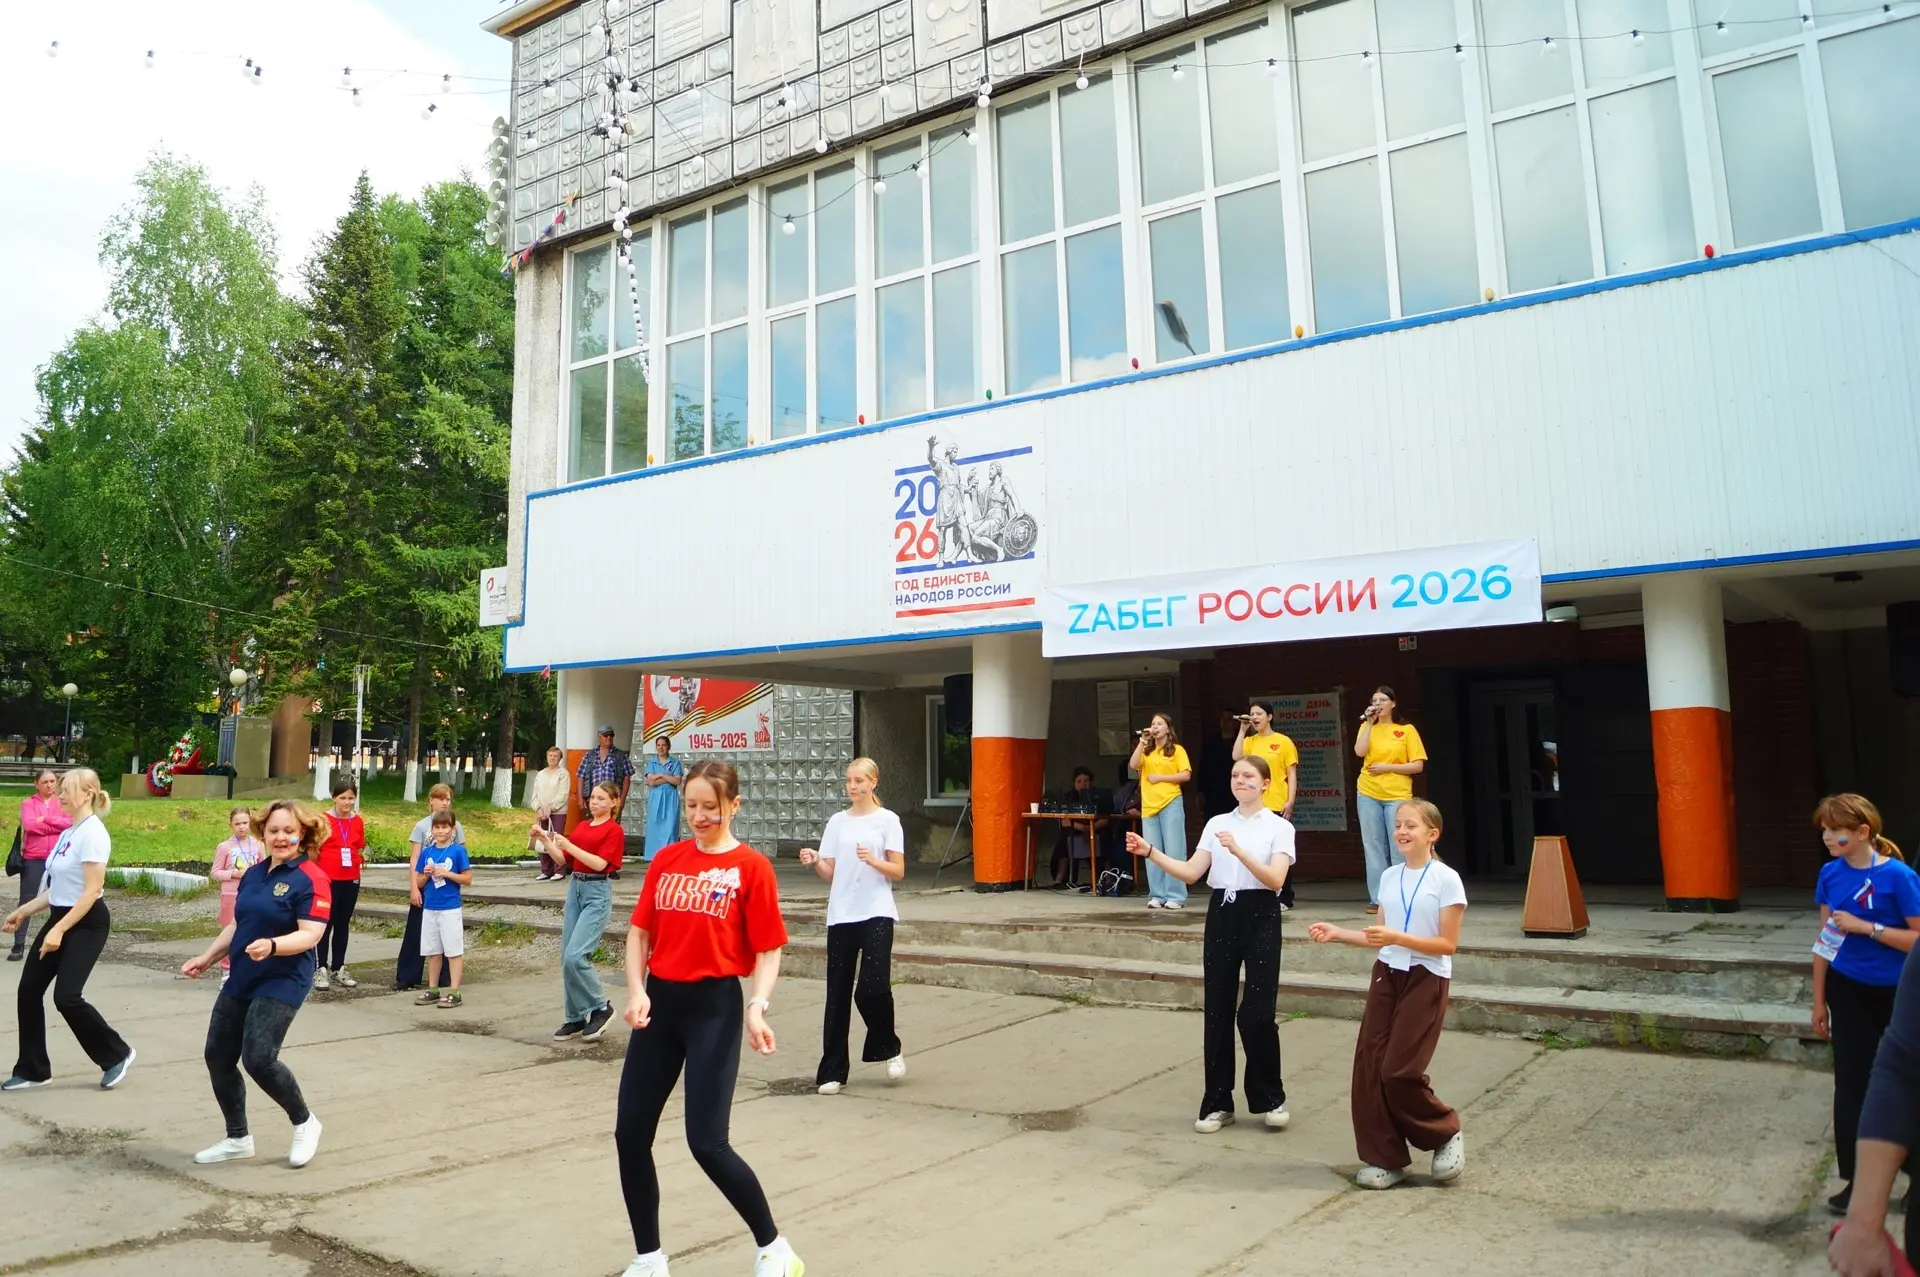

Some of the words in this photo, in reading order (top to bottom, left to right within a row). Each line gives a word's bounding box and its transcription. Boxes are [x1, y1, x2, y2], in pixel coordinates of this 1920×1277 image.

[894, 475, 940, 520] 20
[894, 518, 940, 562] 26
[895, 579, 919, 591] ГОД
[923, 571, 990, 589] ЕДИНСТВА
[895, 589, 954, 605] НАРОДОВ
[958, 583, 1011, 599] РОССИИ
[1068, 595, 1187, 634] ZАБЕГ
[1198, 577, 1377, 624] РОССИИ
[1390, 564, 1512, 609] 2026
[1279, 711, 1319, 719] РОССИИ
[1306, 699, 1331, 710] ДЕНЬ
